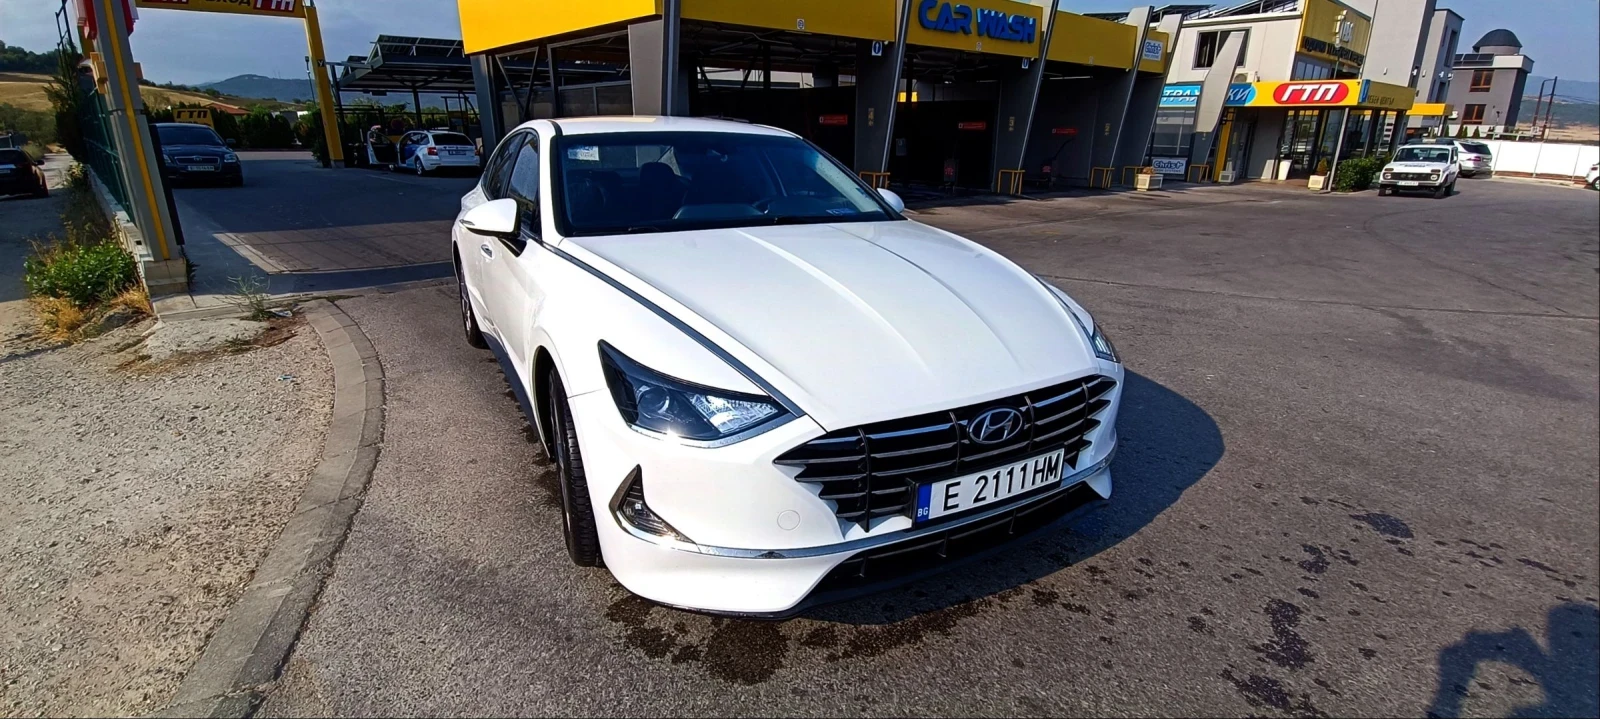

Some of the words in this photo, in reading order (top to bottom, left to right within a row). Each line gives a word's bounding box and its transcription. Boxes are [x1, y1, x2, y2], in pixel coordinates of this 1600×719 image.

[918, 0, 972, 34] CAR
[976, 8, 1036, 43] WASH
[1280, 84, 1340, 102] ГТП
[177, 110, 208, 119] ГТП
[1153, 160, 1184, 169] Christ
[943, 480, 962, 512] E
[917, 506, 929, 518] BG
